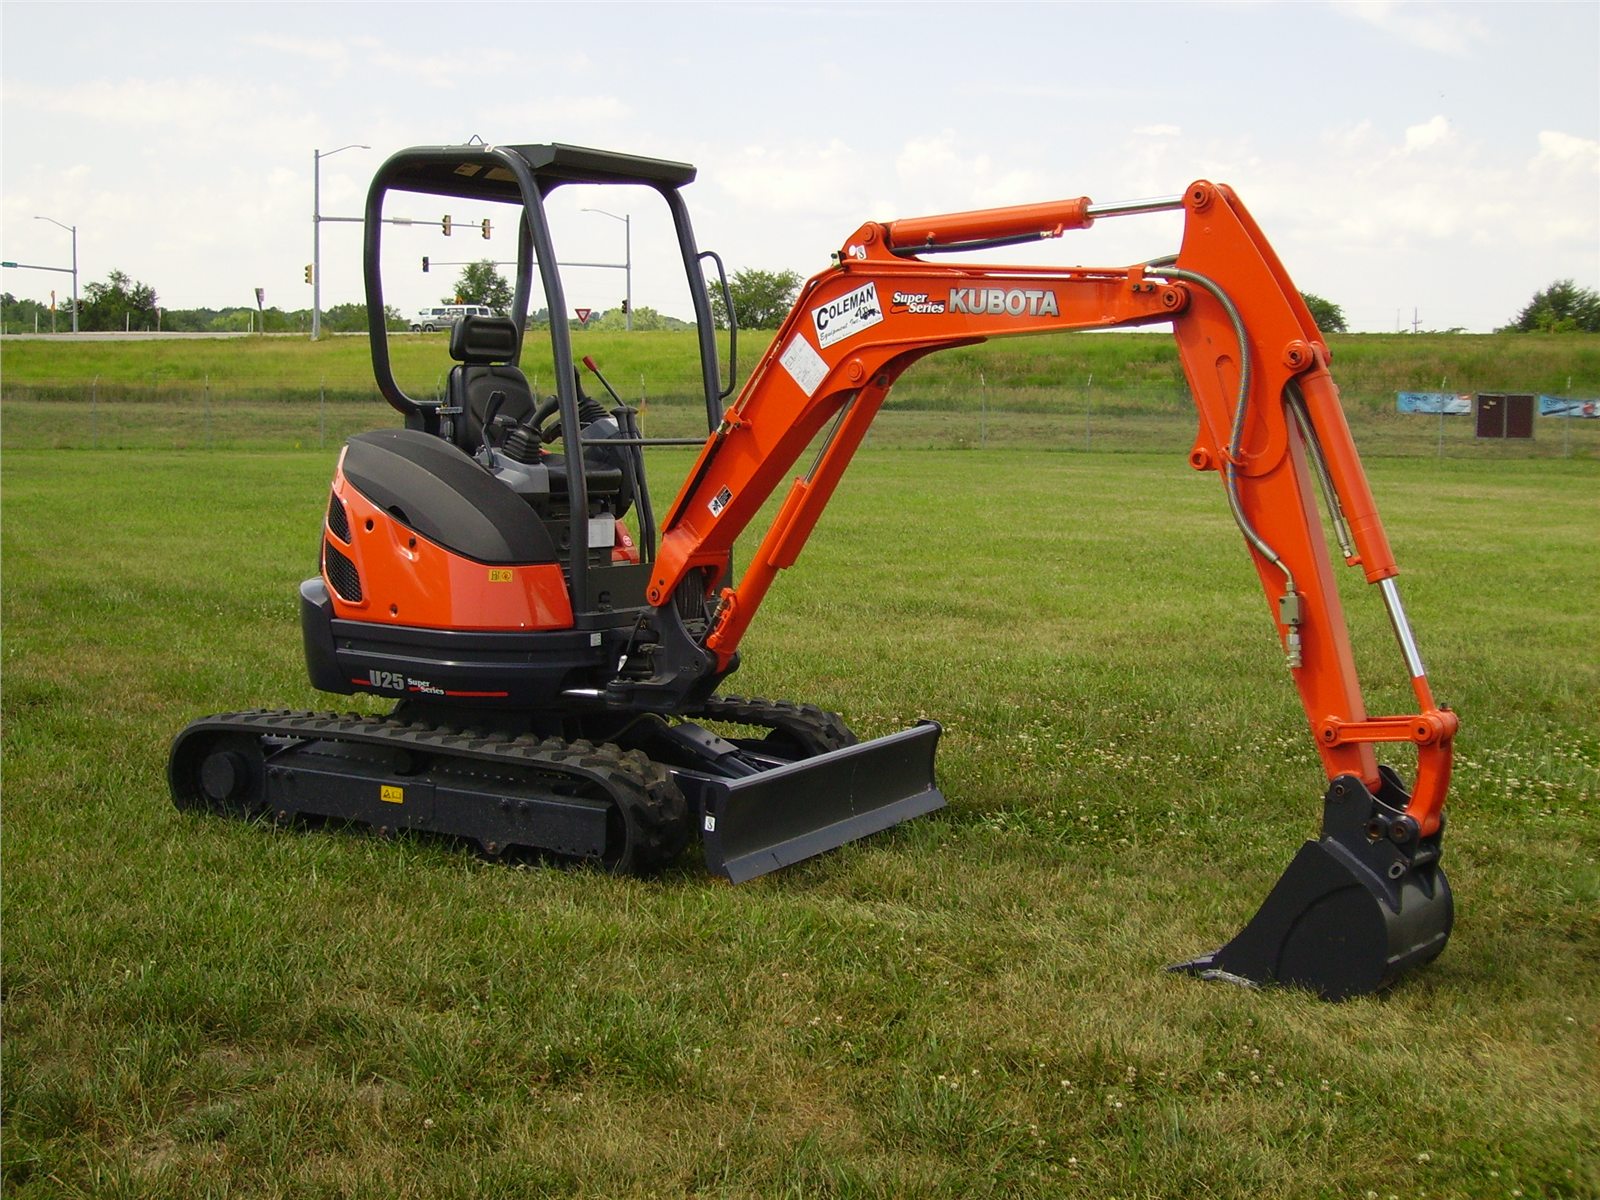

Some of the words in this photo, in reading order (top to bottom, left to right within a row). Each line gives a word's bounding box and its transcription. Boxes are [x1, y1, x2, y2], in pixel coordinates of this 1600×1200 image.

[893, 292, 927, 305] Super
[949, 288, 1059, 316] KUBOTA
[816, 286, 874, 330] COLEMAN
[908, 303, 944, 314] Series
[369, 670, 405, 690] U25
[407, 678, 430, 688] Super
[420, 686, 444, 695] Series
